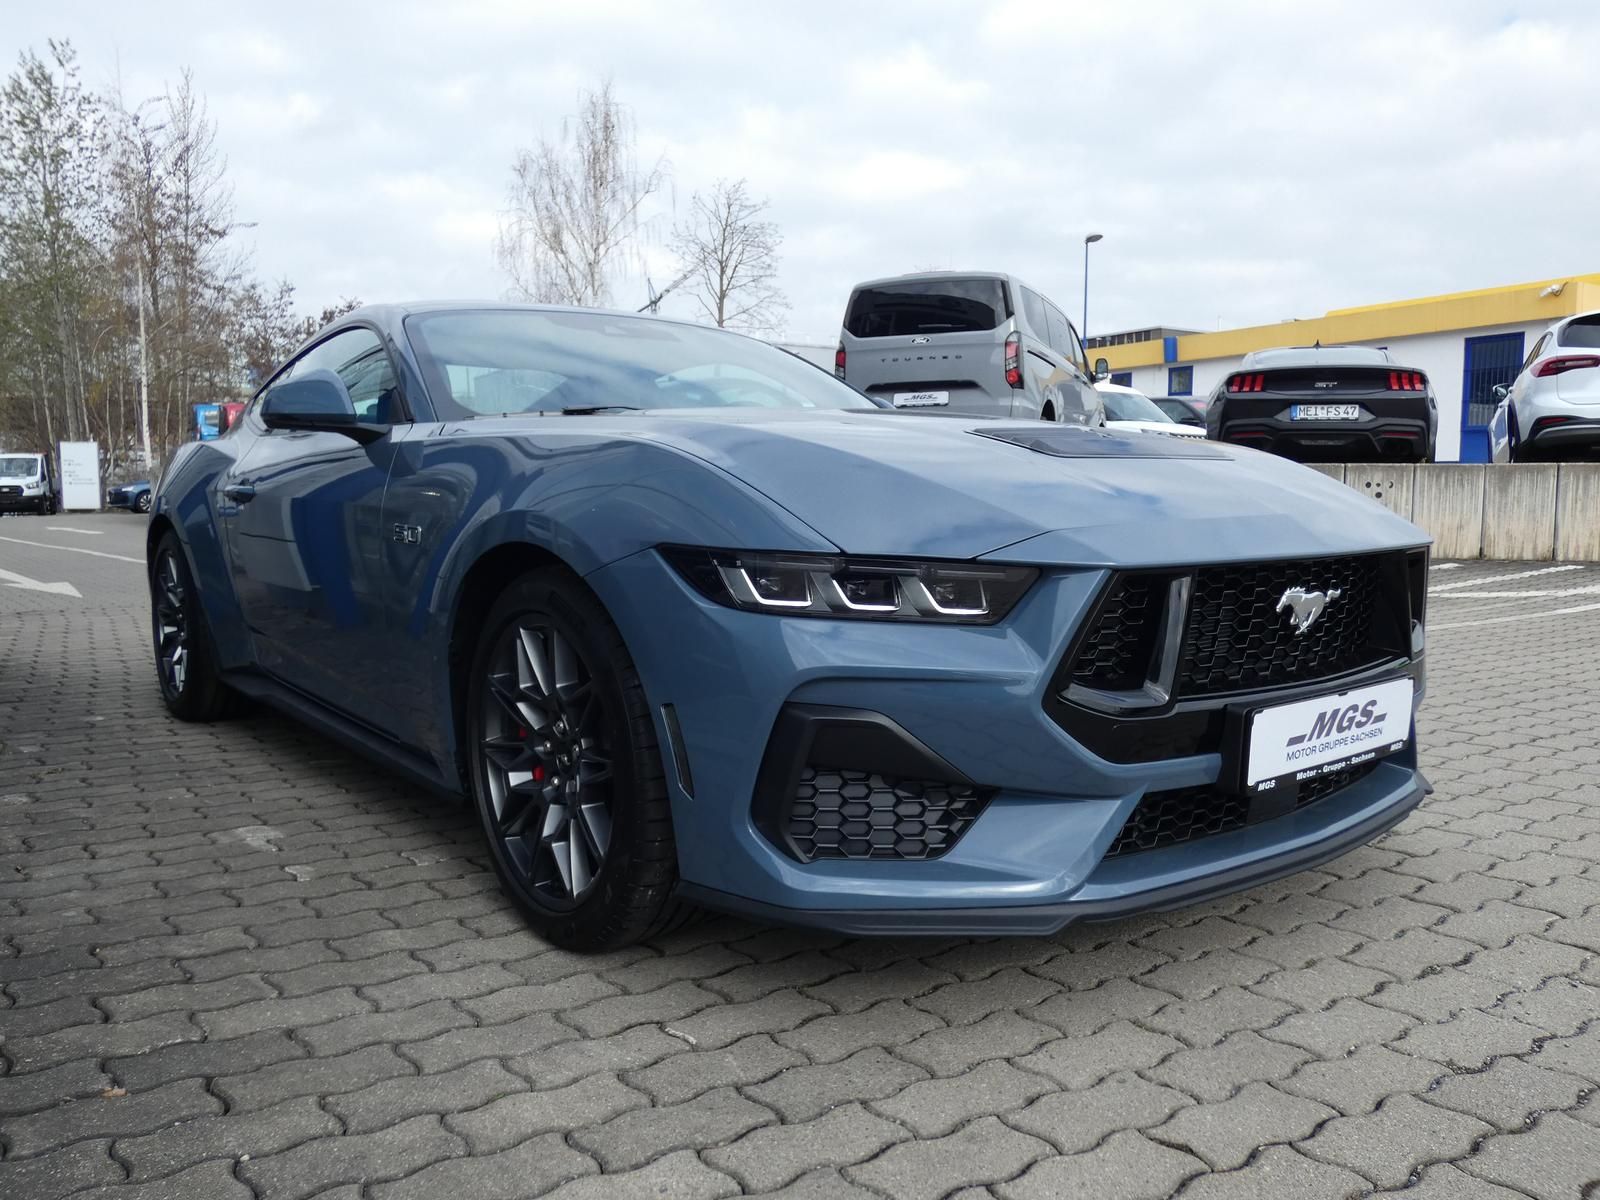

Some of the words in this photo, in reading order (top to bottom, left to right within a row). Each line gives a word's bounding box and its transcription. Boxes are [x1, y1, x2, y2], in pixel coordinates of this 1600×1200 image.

[1299, 407, 1318, 416] MEI
[1307, 699, 1378, 742] MGS
[1286, 745, 1317, 762] MOTOR
[1318, 737, 1349, 753] GRUPPE
[1349, 727, 1383, 746] SACHSEN
[1296, 769, 1317, 780] Motor
[1322, 761, 1346, 773] Gruppe
[1351, 752, 1376, 764] Sachsen
[1257, 780, 1276, 791] MGS
